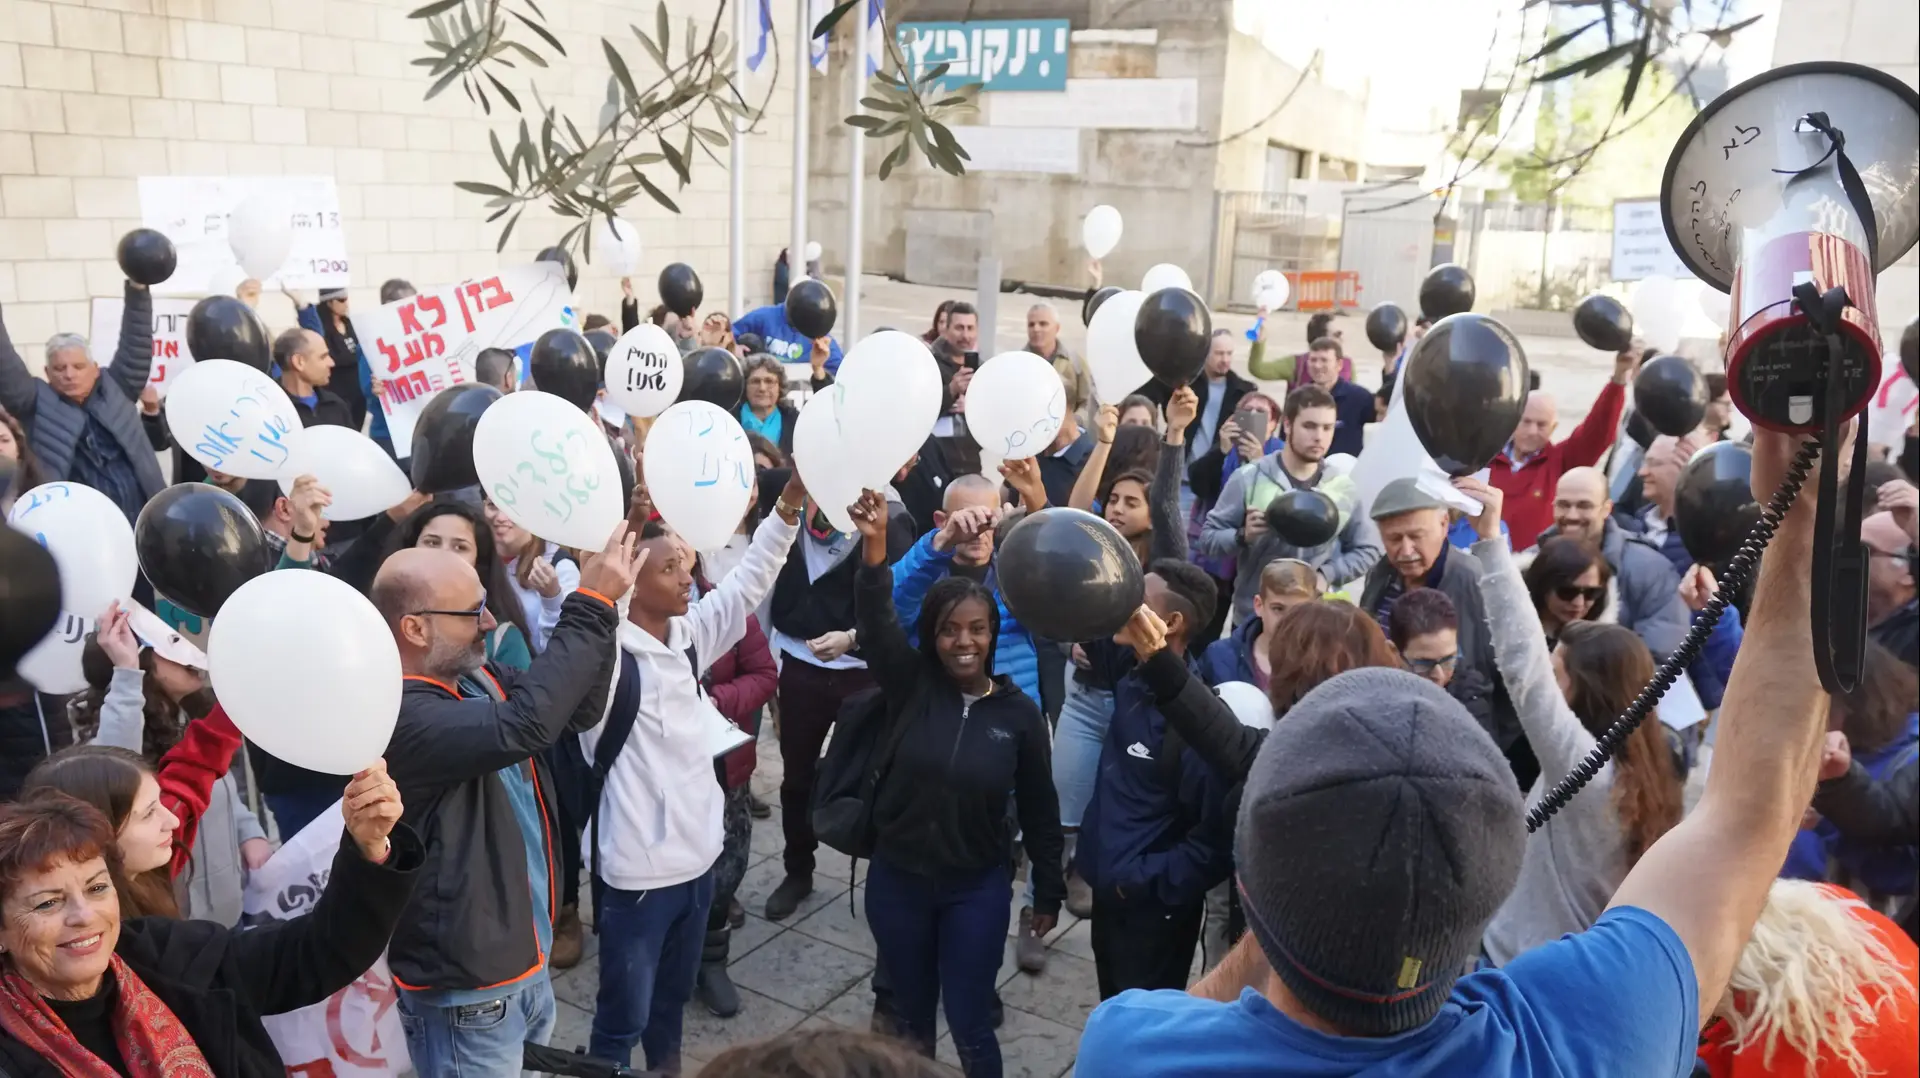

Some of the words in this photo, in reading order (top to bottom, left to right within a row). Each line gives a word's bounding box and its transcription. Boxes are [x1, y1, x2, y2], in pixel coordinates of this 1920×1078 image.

[1723, 125, 1761, 160] לא
[308, 257, 349, 274] 1200
[396, 294, 448, 336] לא
[375, 331, 447, 374] מעל
[626, 346, 668, 369] החיים
[542, 472, 600, 525] שלנו
